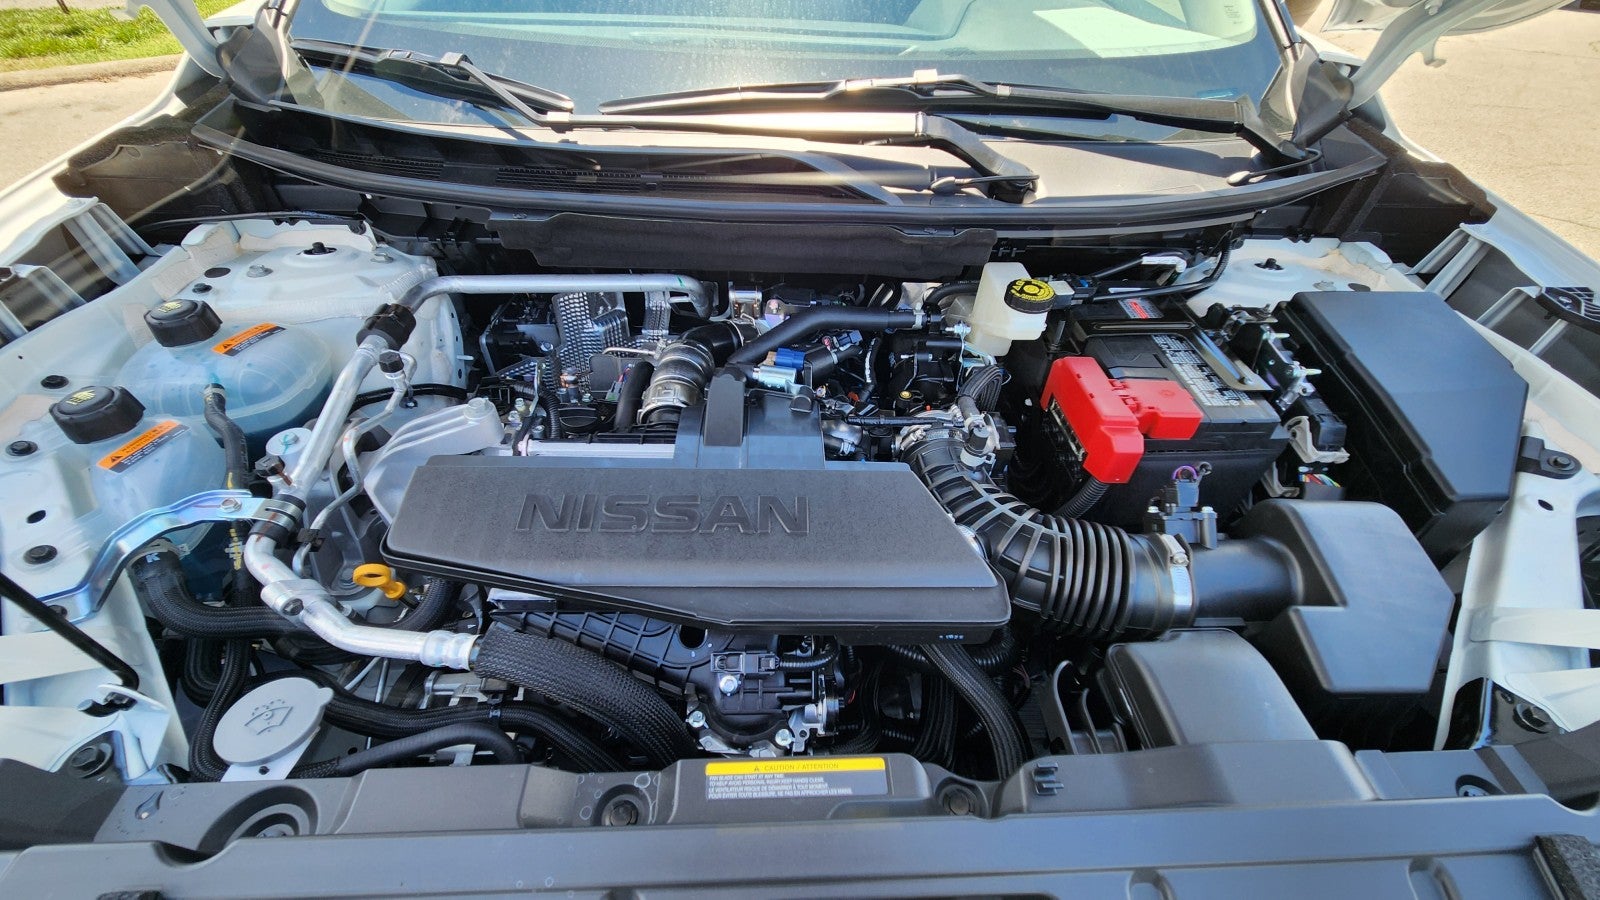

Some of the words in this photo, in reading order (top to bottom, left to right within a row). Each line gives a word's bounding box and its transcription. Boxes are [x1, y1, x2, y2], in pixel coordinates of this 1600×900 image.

[515, 494, 809, 533] NISSAN
[763, 764, 795, 772] CAUTION
[802, 762, 839, 770] ATTENTION
